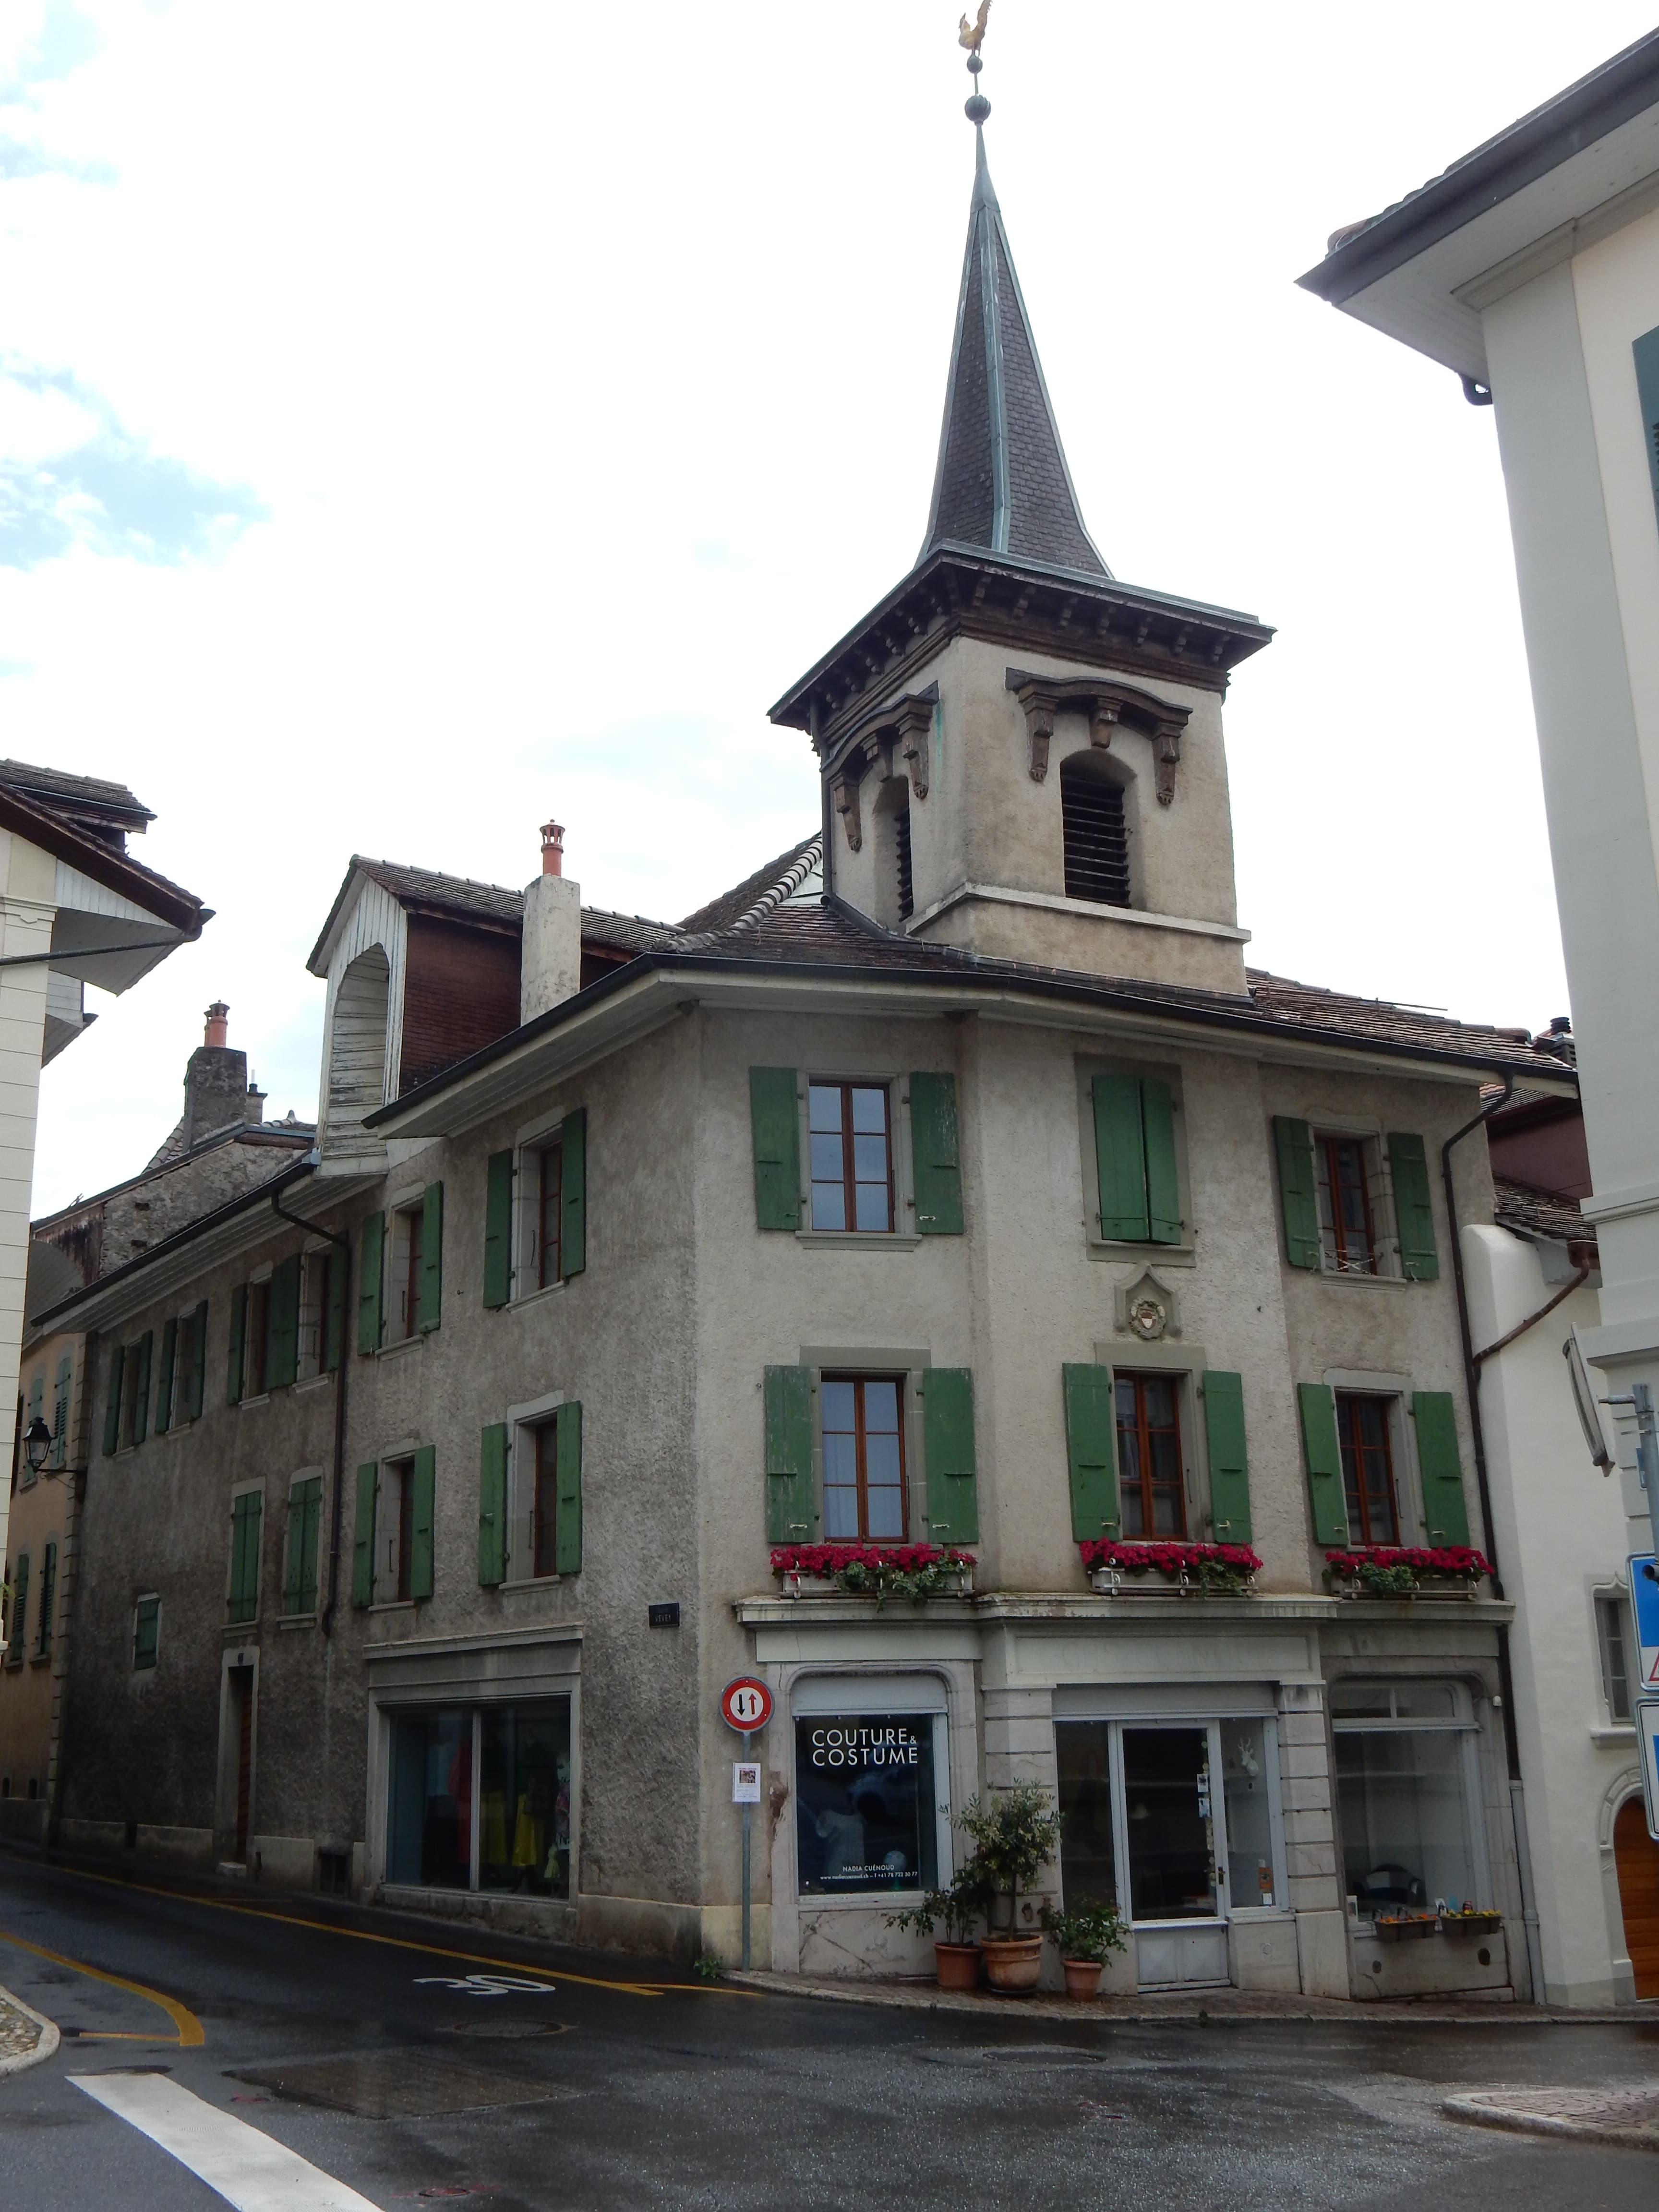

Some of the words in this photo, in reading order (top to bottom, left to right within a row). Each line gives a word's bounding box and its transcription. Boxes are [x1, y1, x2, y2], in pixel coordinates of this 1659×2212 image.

[812, 1729, 907, 1746] COUTURE
[812, 1747, 918, 1766] COSTUME
[412, 1975, 555, 1995] 30
